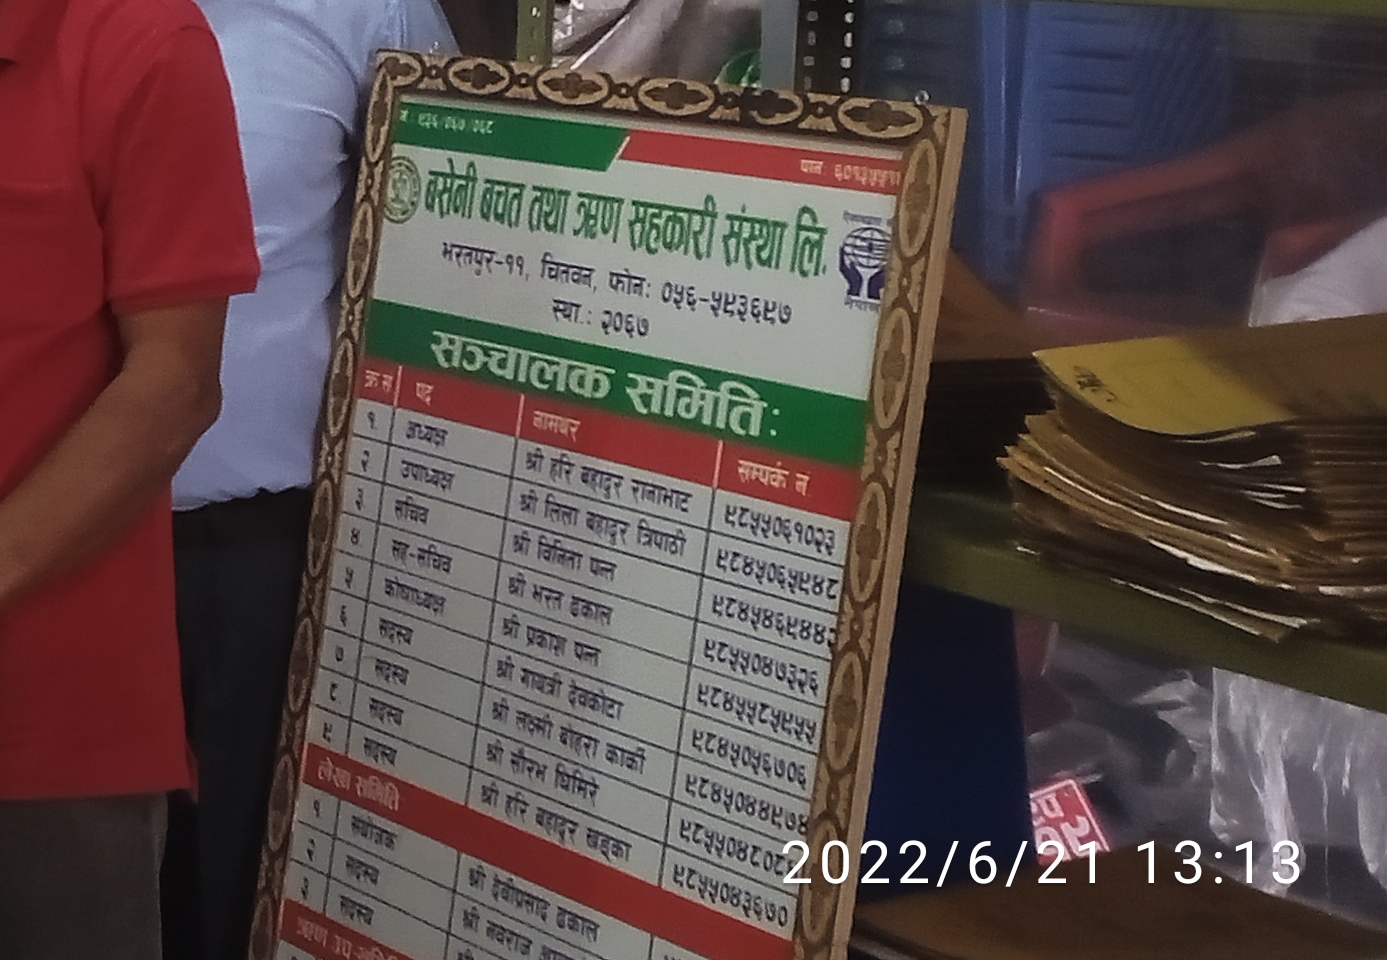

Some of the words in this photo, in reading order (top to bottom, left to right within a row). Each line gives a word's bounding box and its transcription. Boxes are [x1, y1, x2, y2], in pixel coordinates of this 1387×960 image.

[479, 178, 526, 229] बचत
[528, 185, 571, 235] तथा
[628, 194, 718, 261] सहकारी
[721, 203, 788, 271] संस्था
[600, 308, 649, 338] २०६७
[429, 331, 616, 399] सञ्चालक
[519, 489, 539, 515] श्री
[544, 492, 580, 527] लिला
[524, 447, 545, 474] श्री
[549, 452, 575, 485] हरि
[631, 478, 693, 514] रानाभाट
